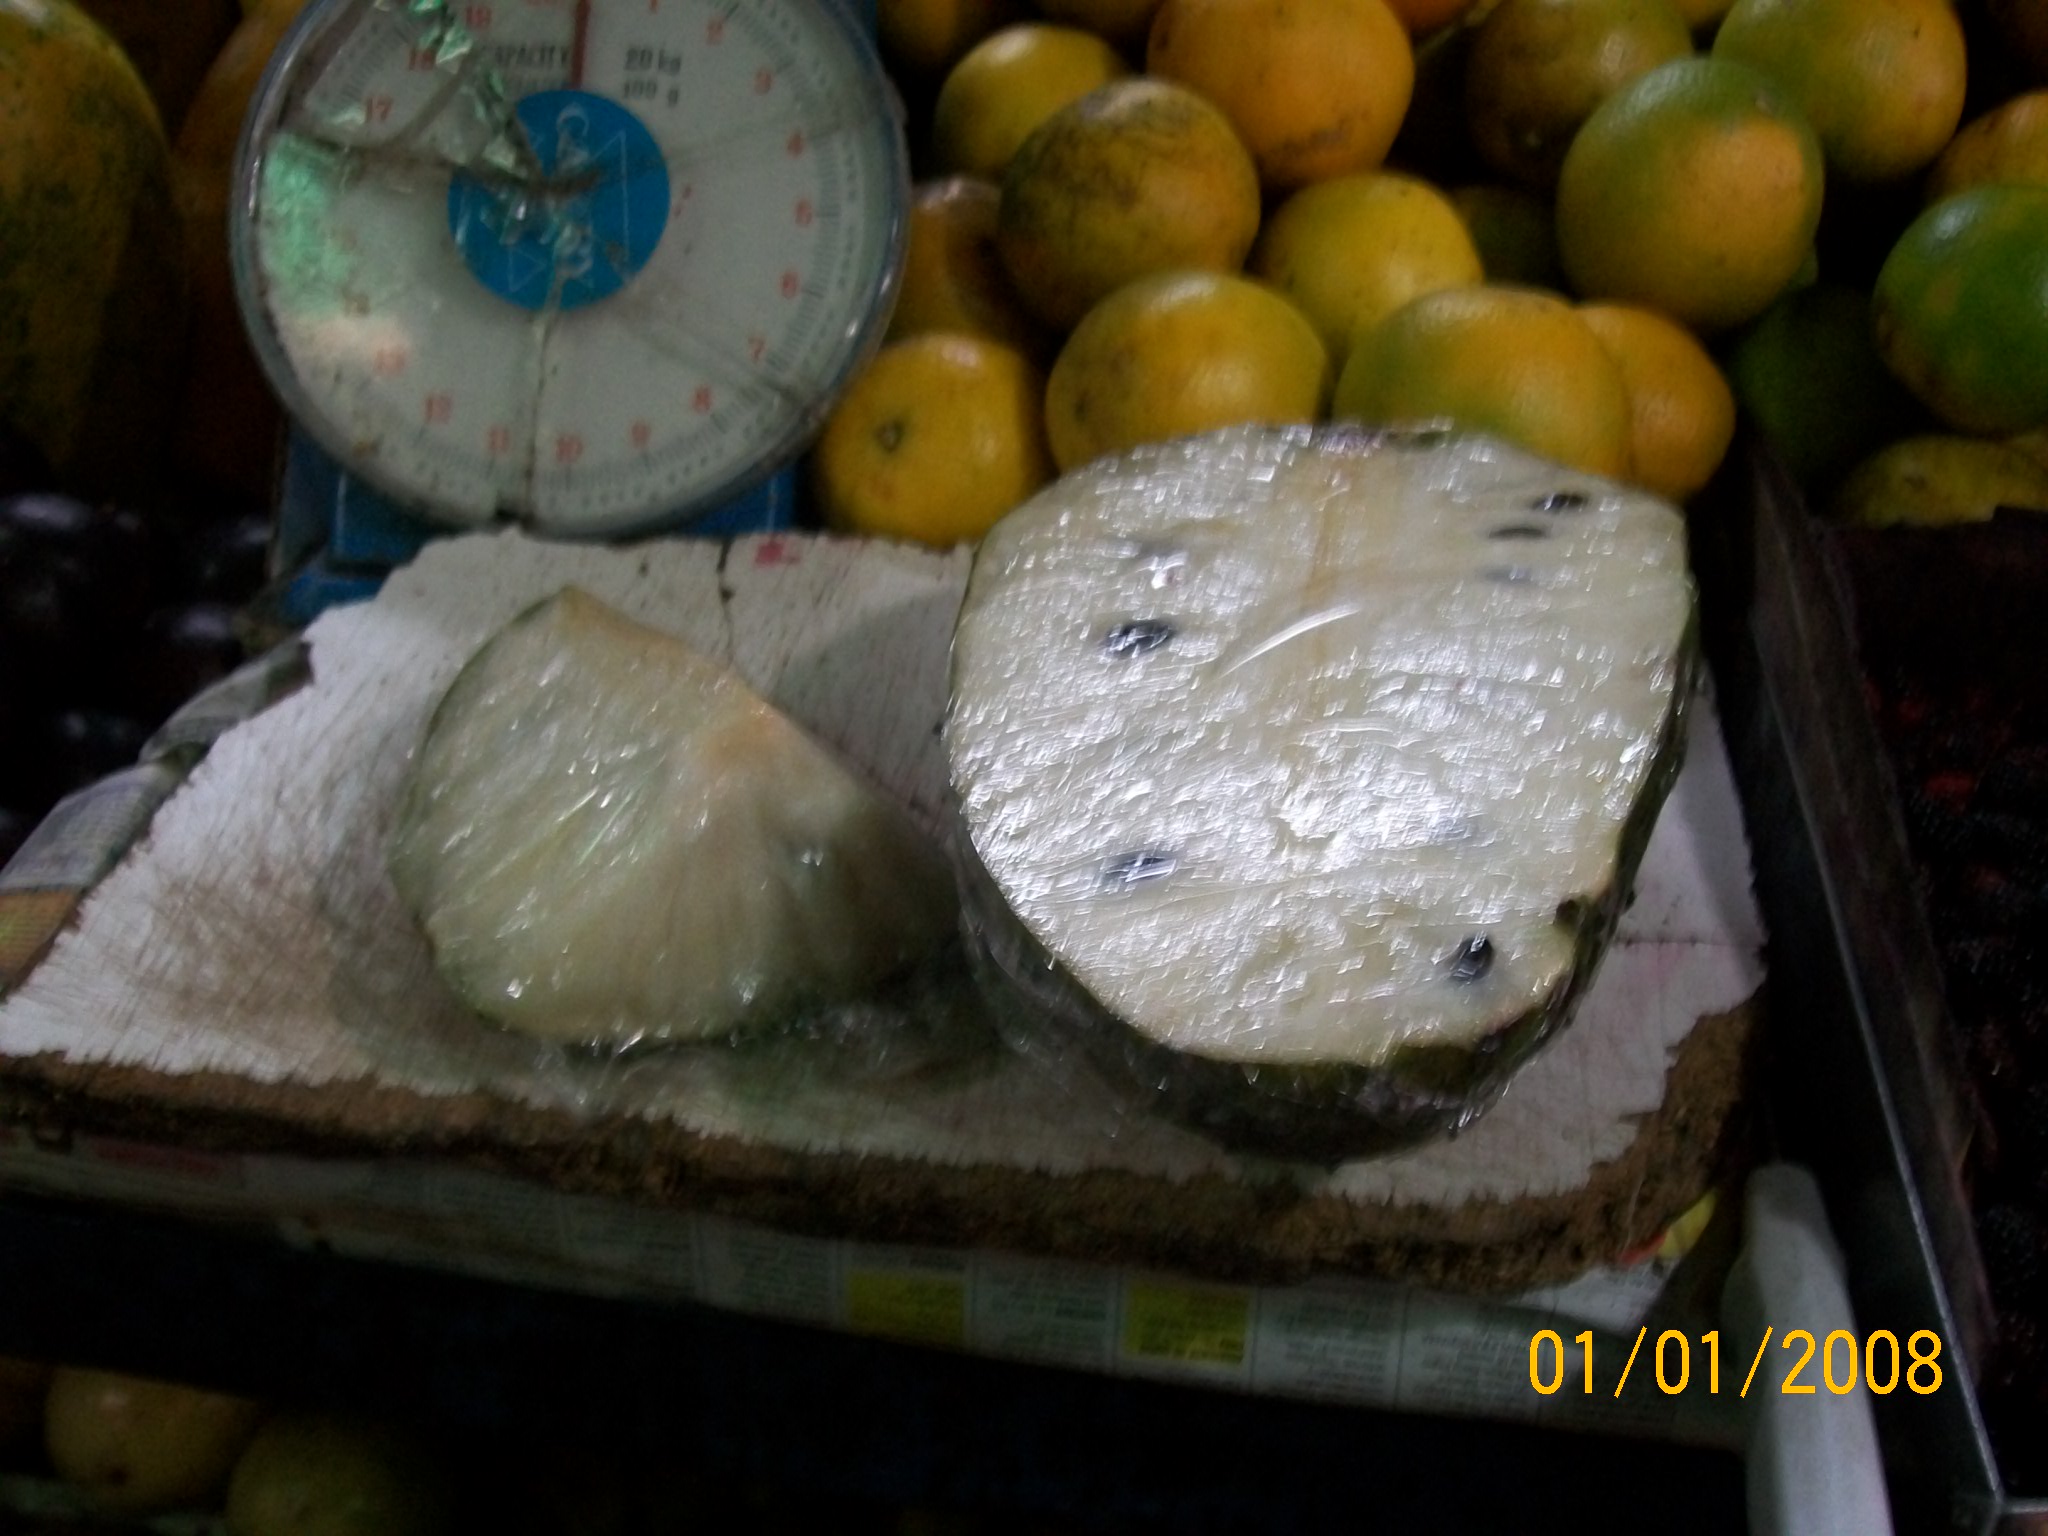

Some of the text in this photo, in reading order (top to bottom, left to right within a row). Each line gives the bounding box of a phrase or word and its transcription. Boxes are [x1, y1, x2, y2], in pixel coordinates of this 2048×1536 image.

[624, 47, 654, 71] 20
[366, 93, 393, 122] 17
[748, 335, 766, 361] 7
